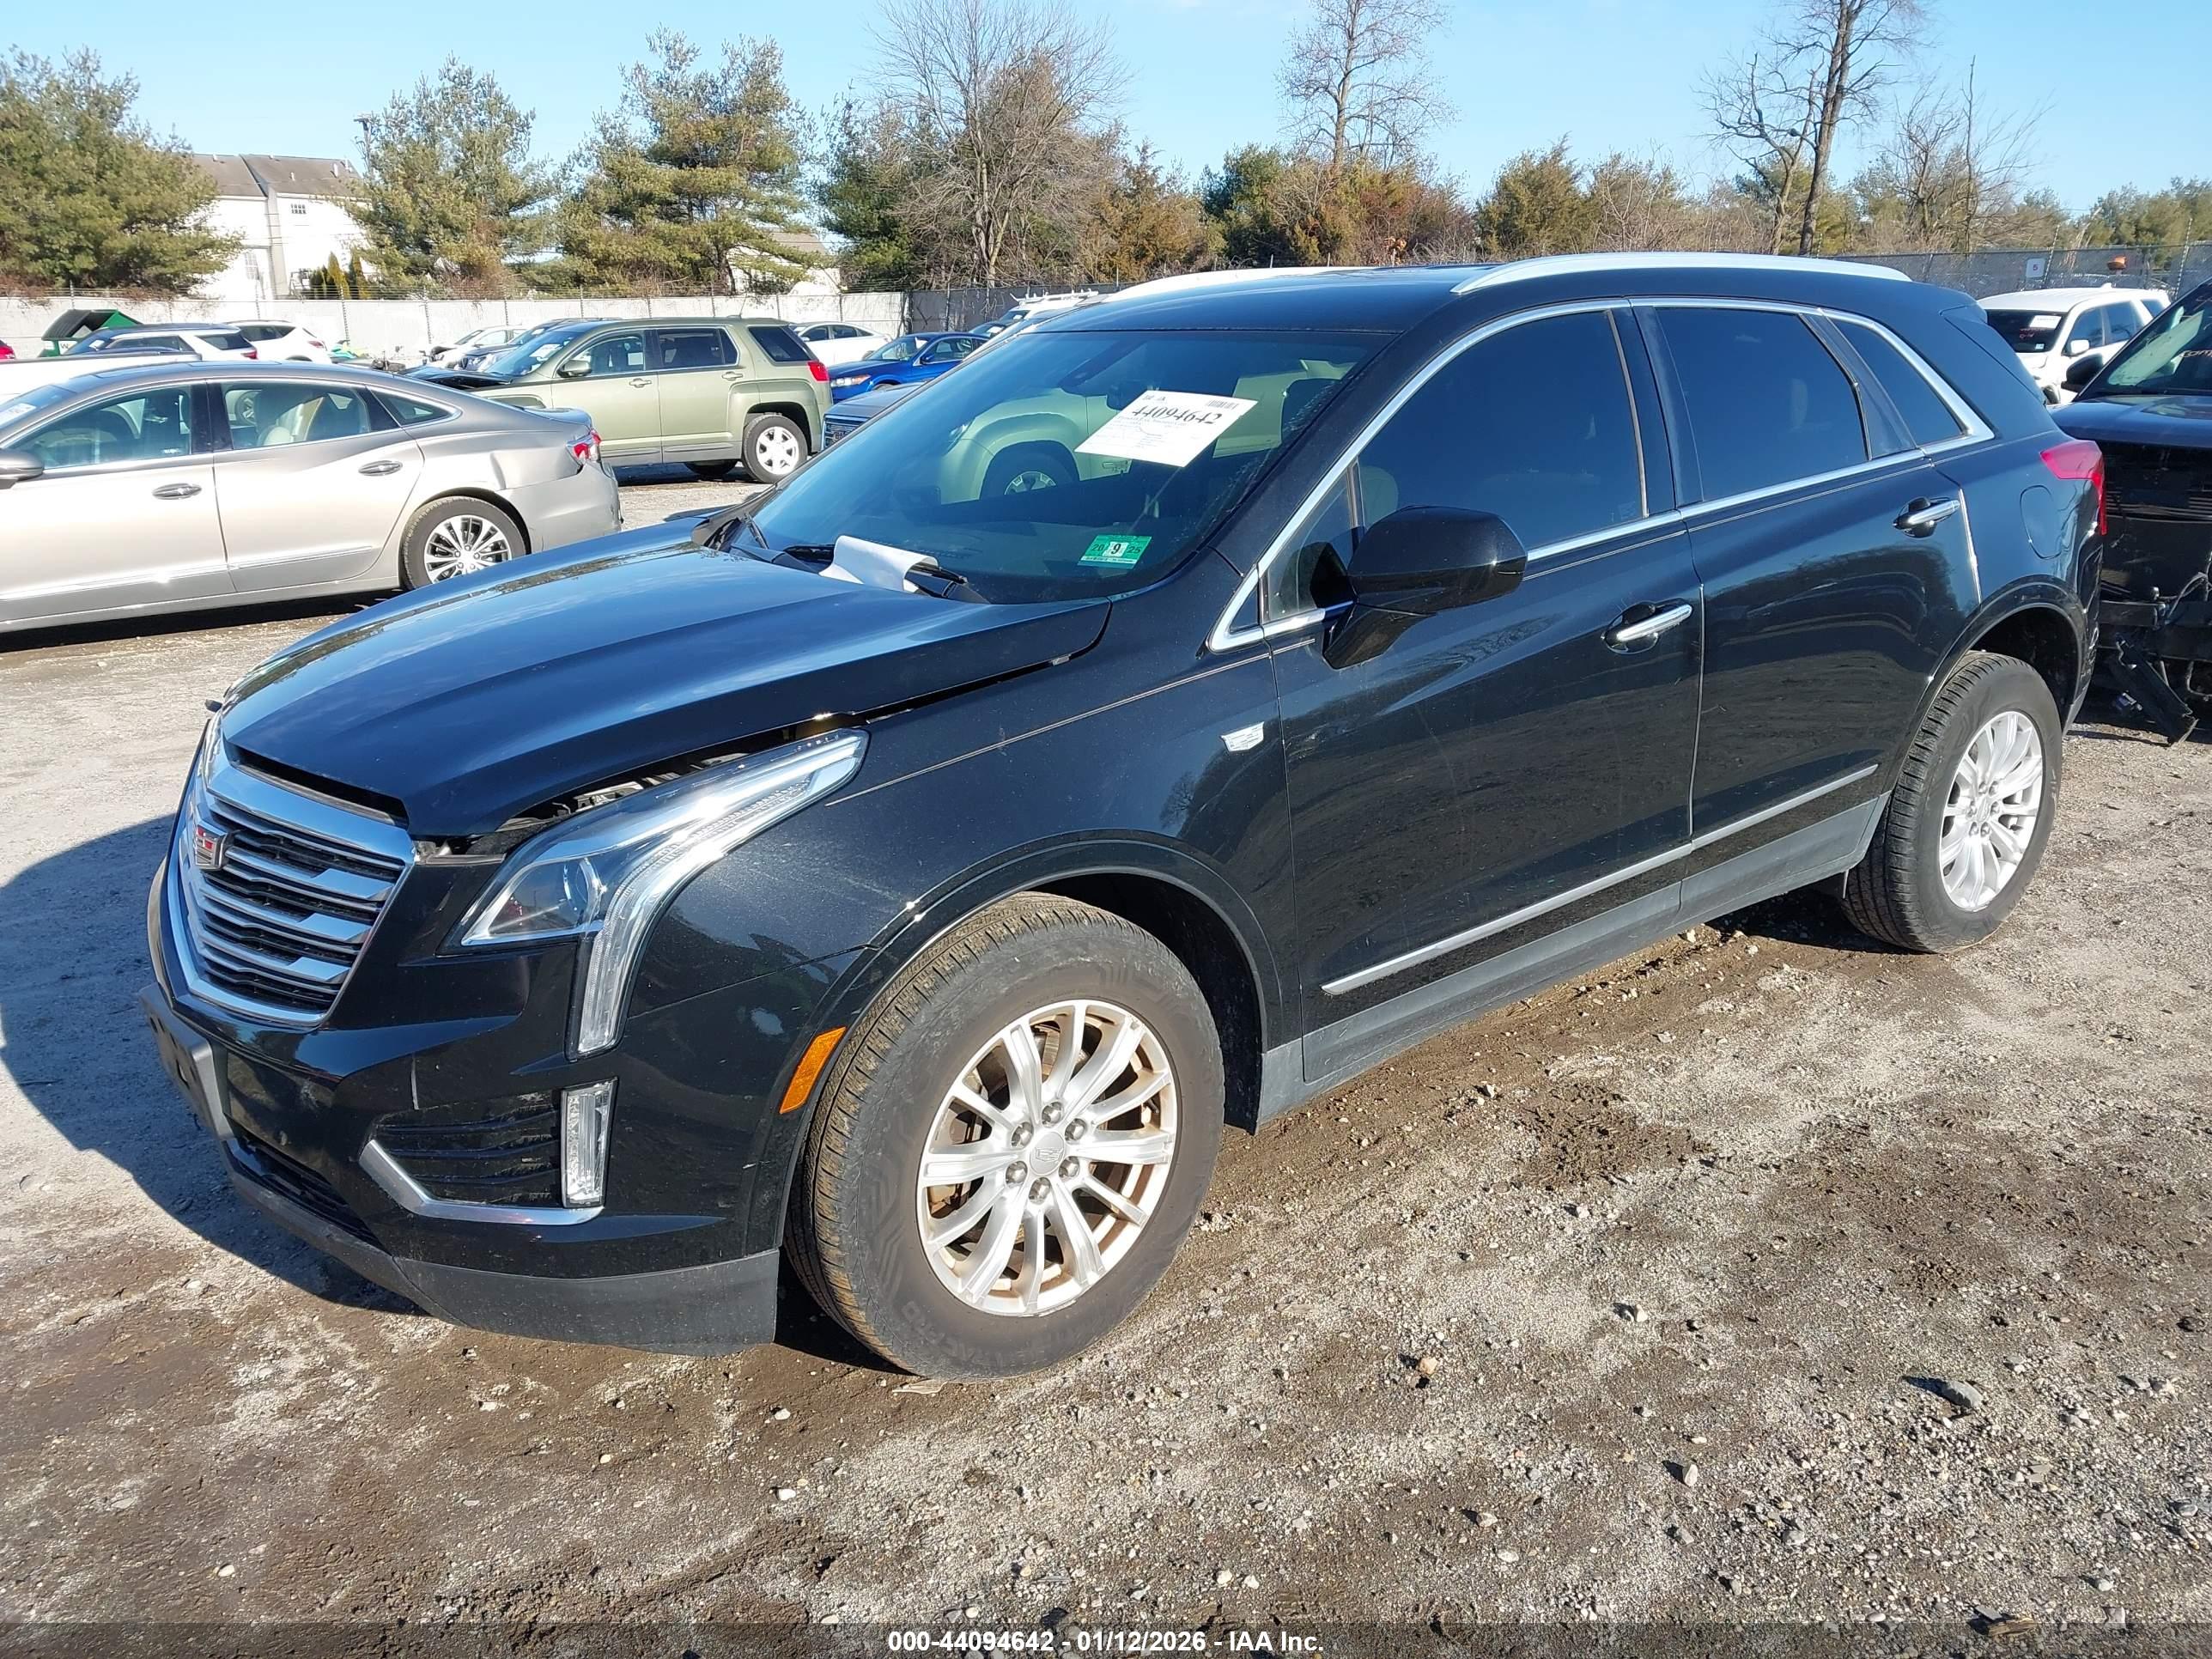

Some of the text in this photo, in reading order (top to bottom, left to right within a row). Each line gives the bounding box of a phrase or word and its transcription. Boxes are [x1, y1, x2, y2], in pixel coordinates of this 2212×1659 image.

[1132, 405, 1223, 424] 44094642
[1110, 543, 1121, 554] 9
[1126, 545, 1141, 554] 25
